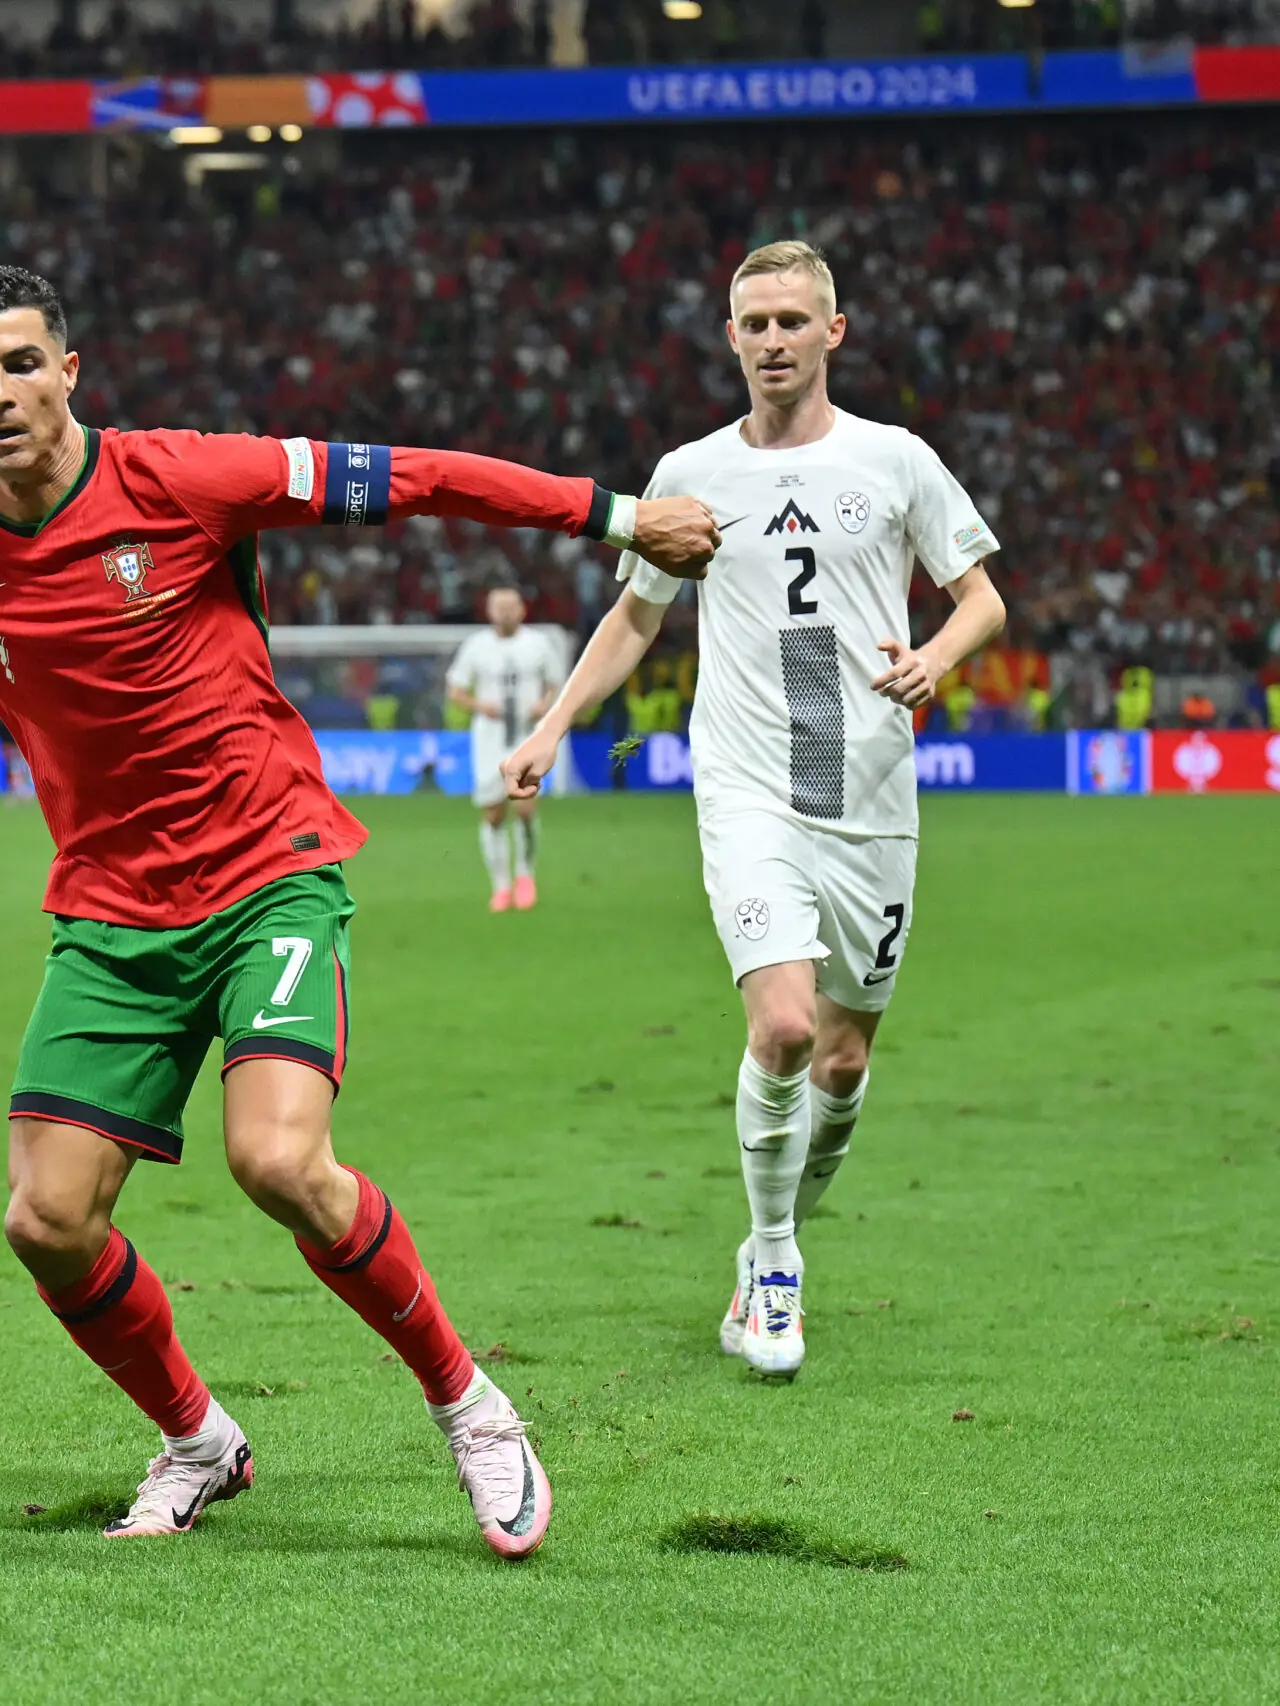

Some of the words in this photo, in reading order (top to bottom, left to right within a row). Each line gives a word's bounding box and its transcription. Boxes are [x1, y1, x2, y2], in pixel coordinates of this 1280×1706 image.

[349, 482, 364, 525] ESPECT
[784, 546, 819, 615] 2
[875, 903, 905, 969] 2
[270, 936, 313, 1006] 7
